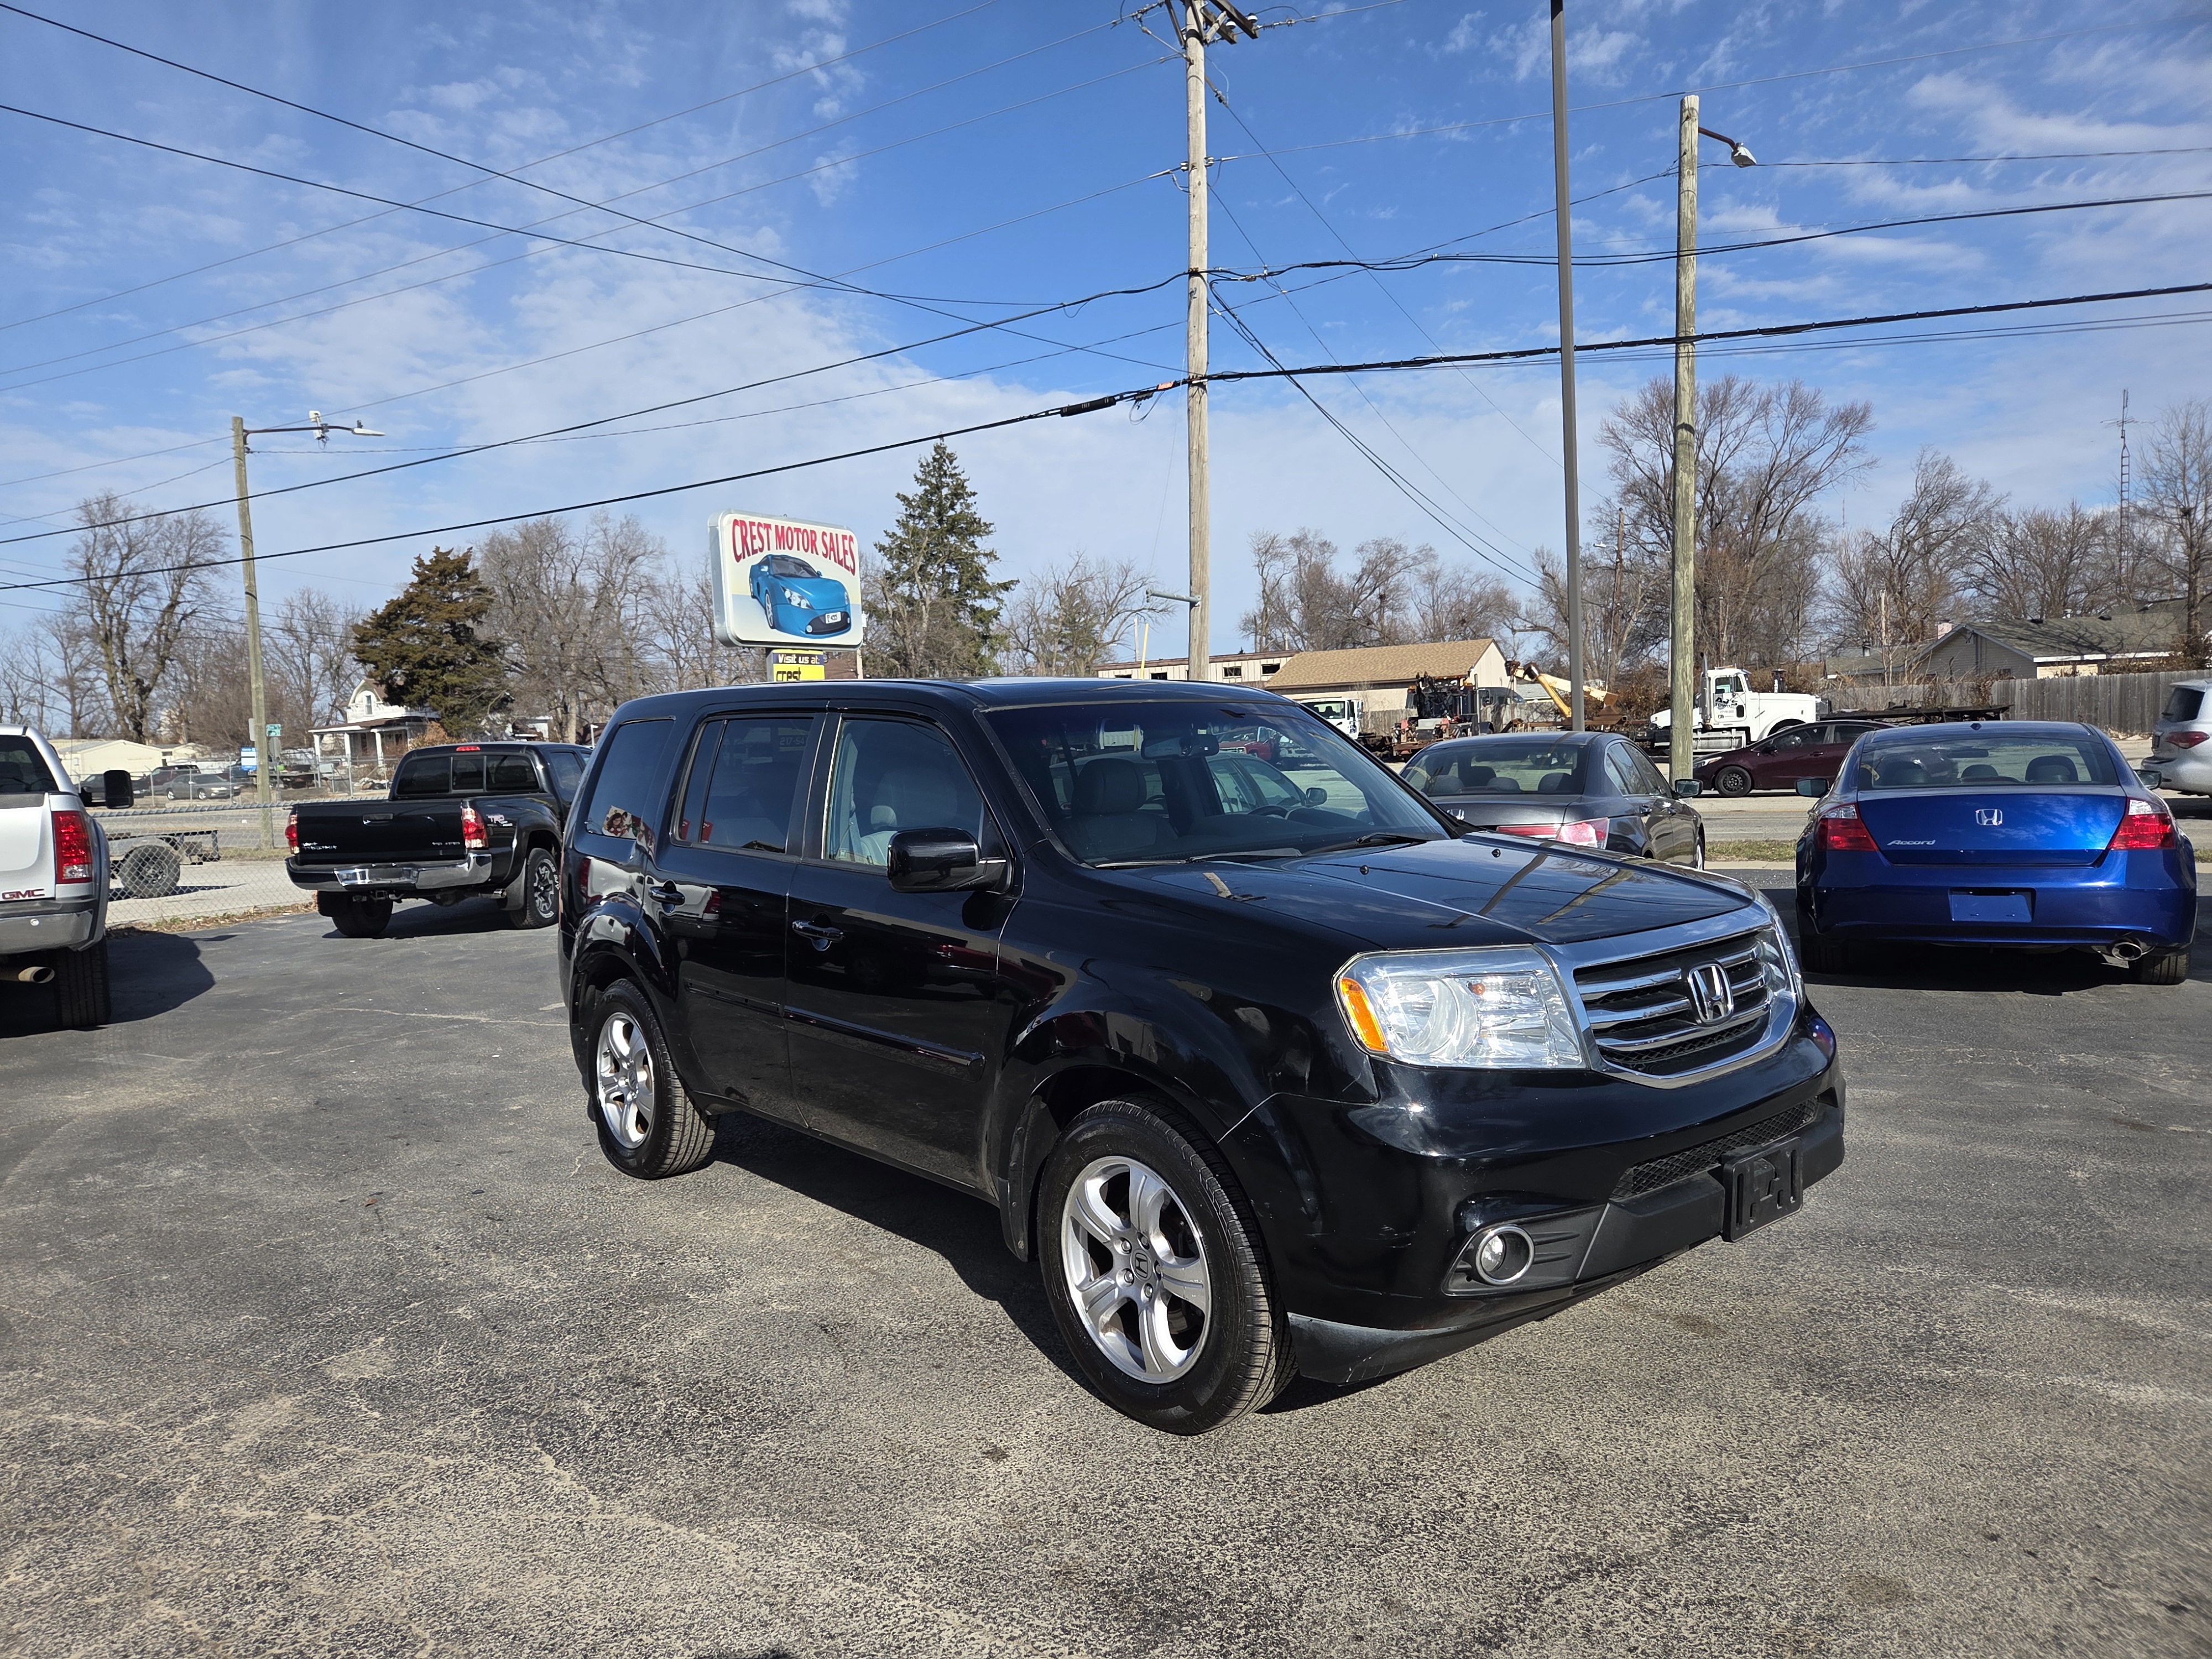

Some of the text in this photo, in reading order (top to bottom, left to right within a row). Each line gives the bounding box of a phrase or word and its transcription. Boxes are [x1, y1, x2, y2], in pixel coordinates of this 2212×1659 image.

[732, 519, 855, 576] CREST MOTOR SALES
[778, 654, 796, 664] Visit
[2, 888, 45, 900] GMC
